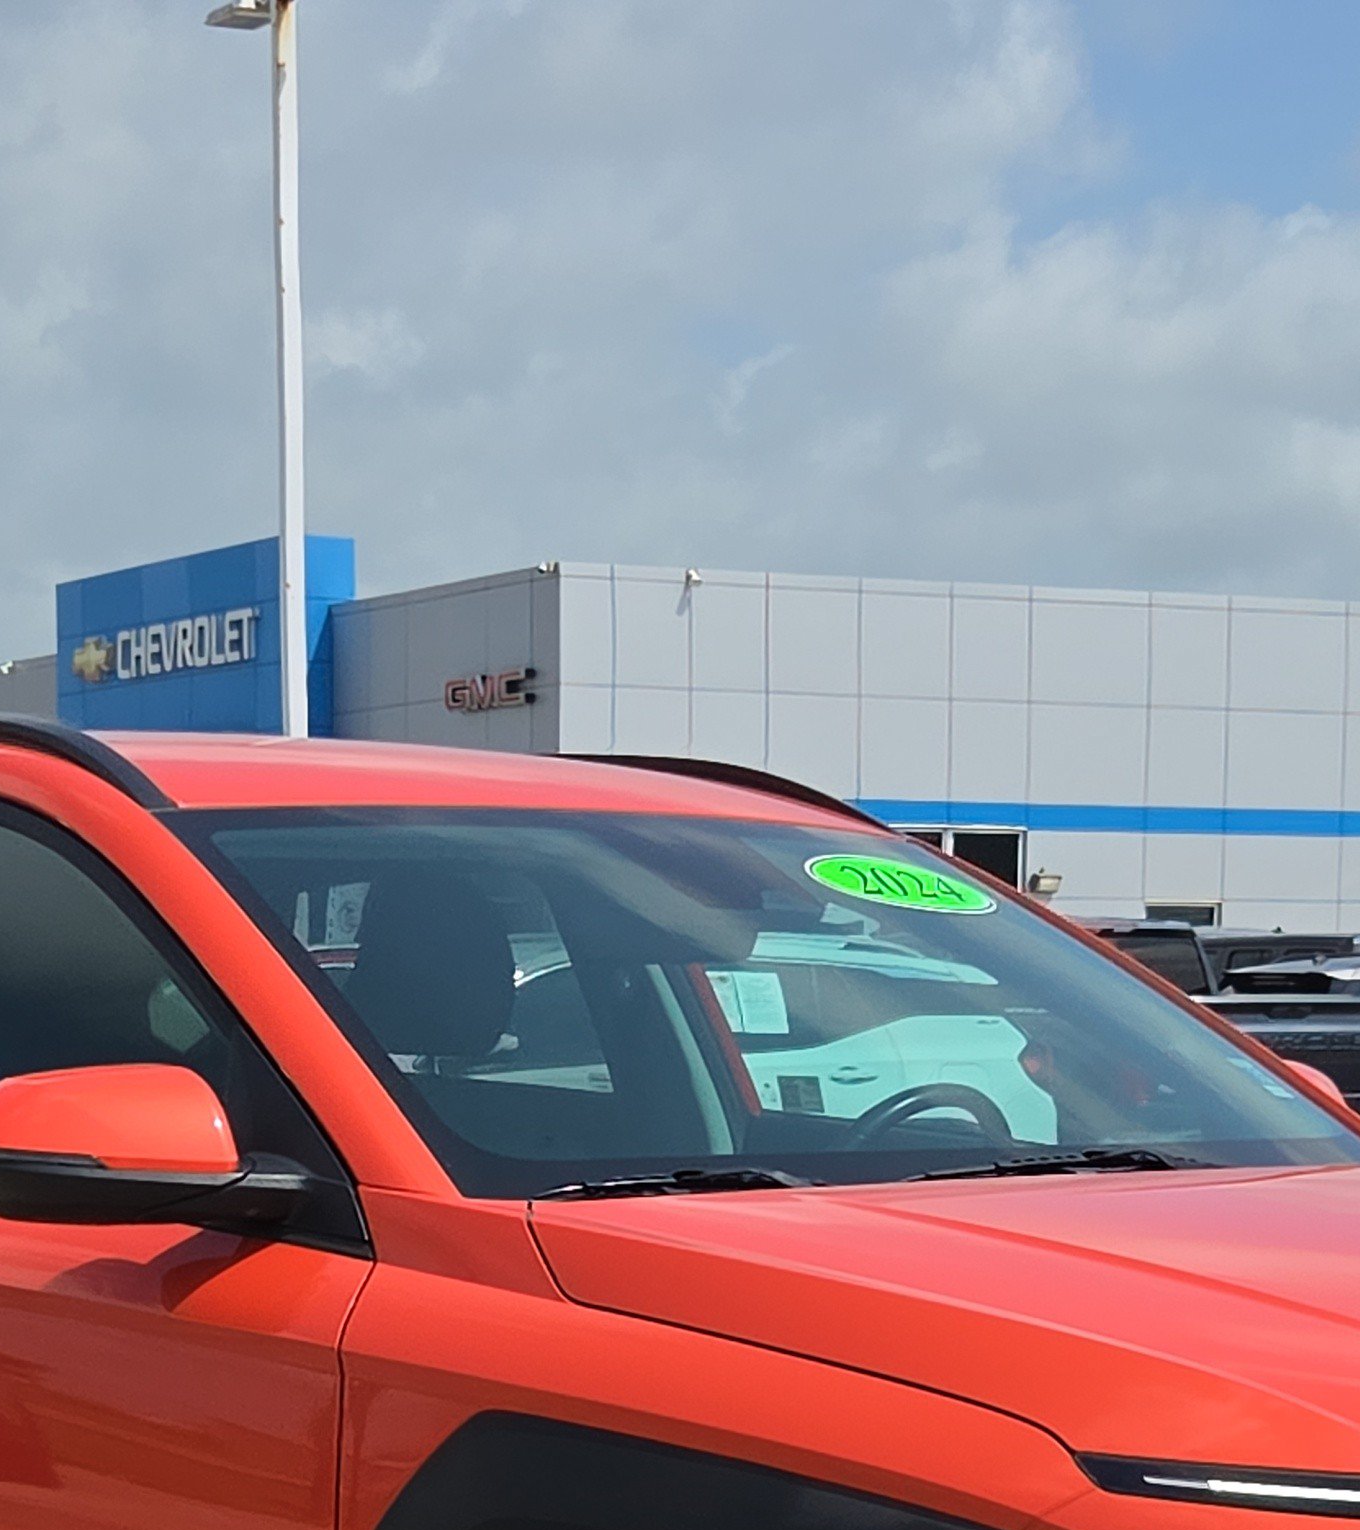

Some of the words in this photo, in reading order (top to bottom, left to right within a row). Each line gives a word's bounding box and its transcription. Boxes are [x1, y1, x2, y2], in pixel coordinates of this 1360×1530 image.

[117, 608, 255, 680] CHEVROLET
[444, 669, 526, 711] GMC
[840, 865, 966, 902] 2024
